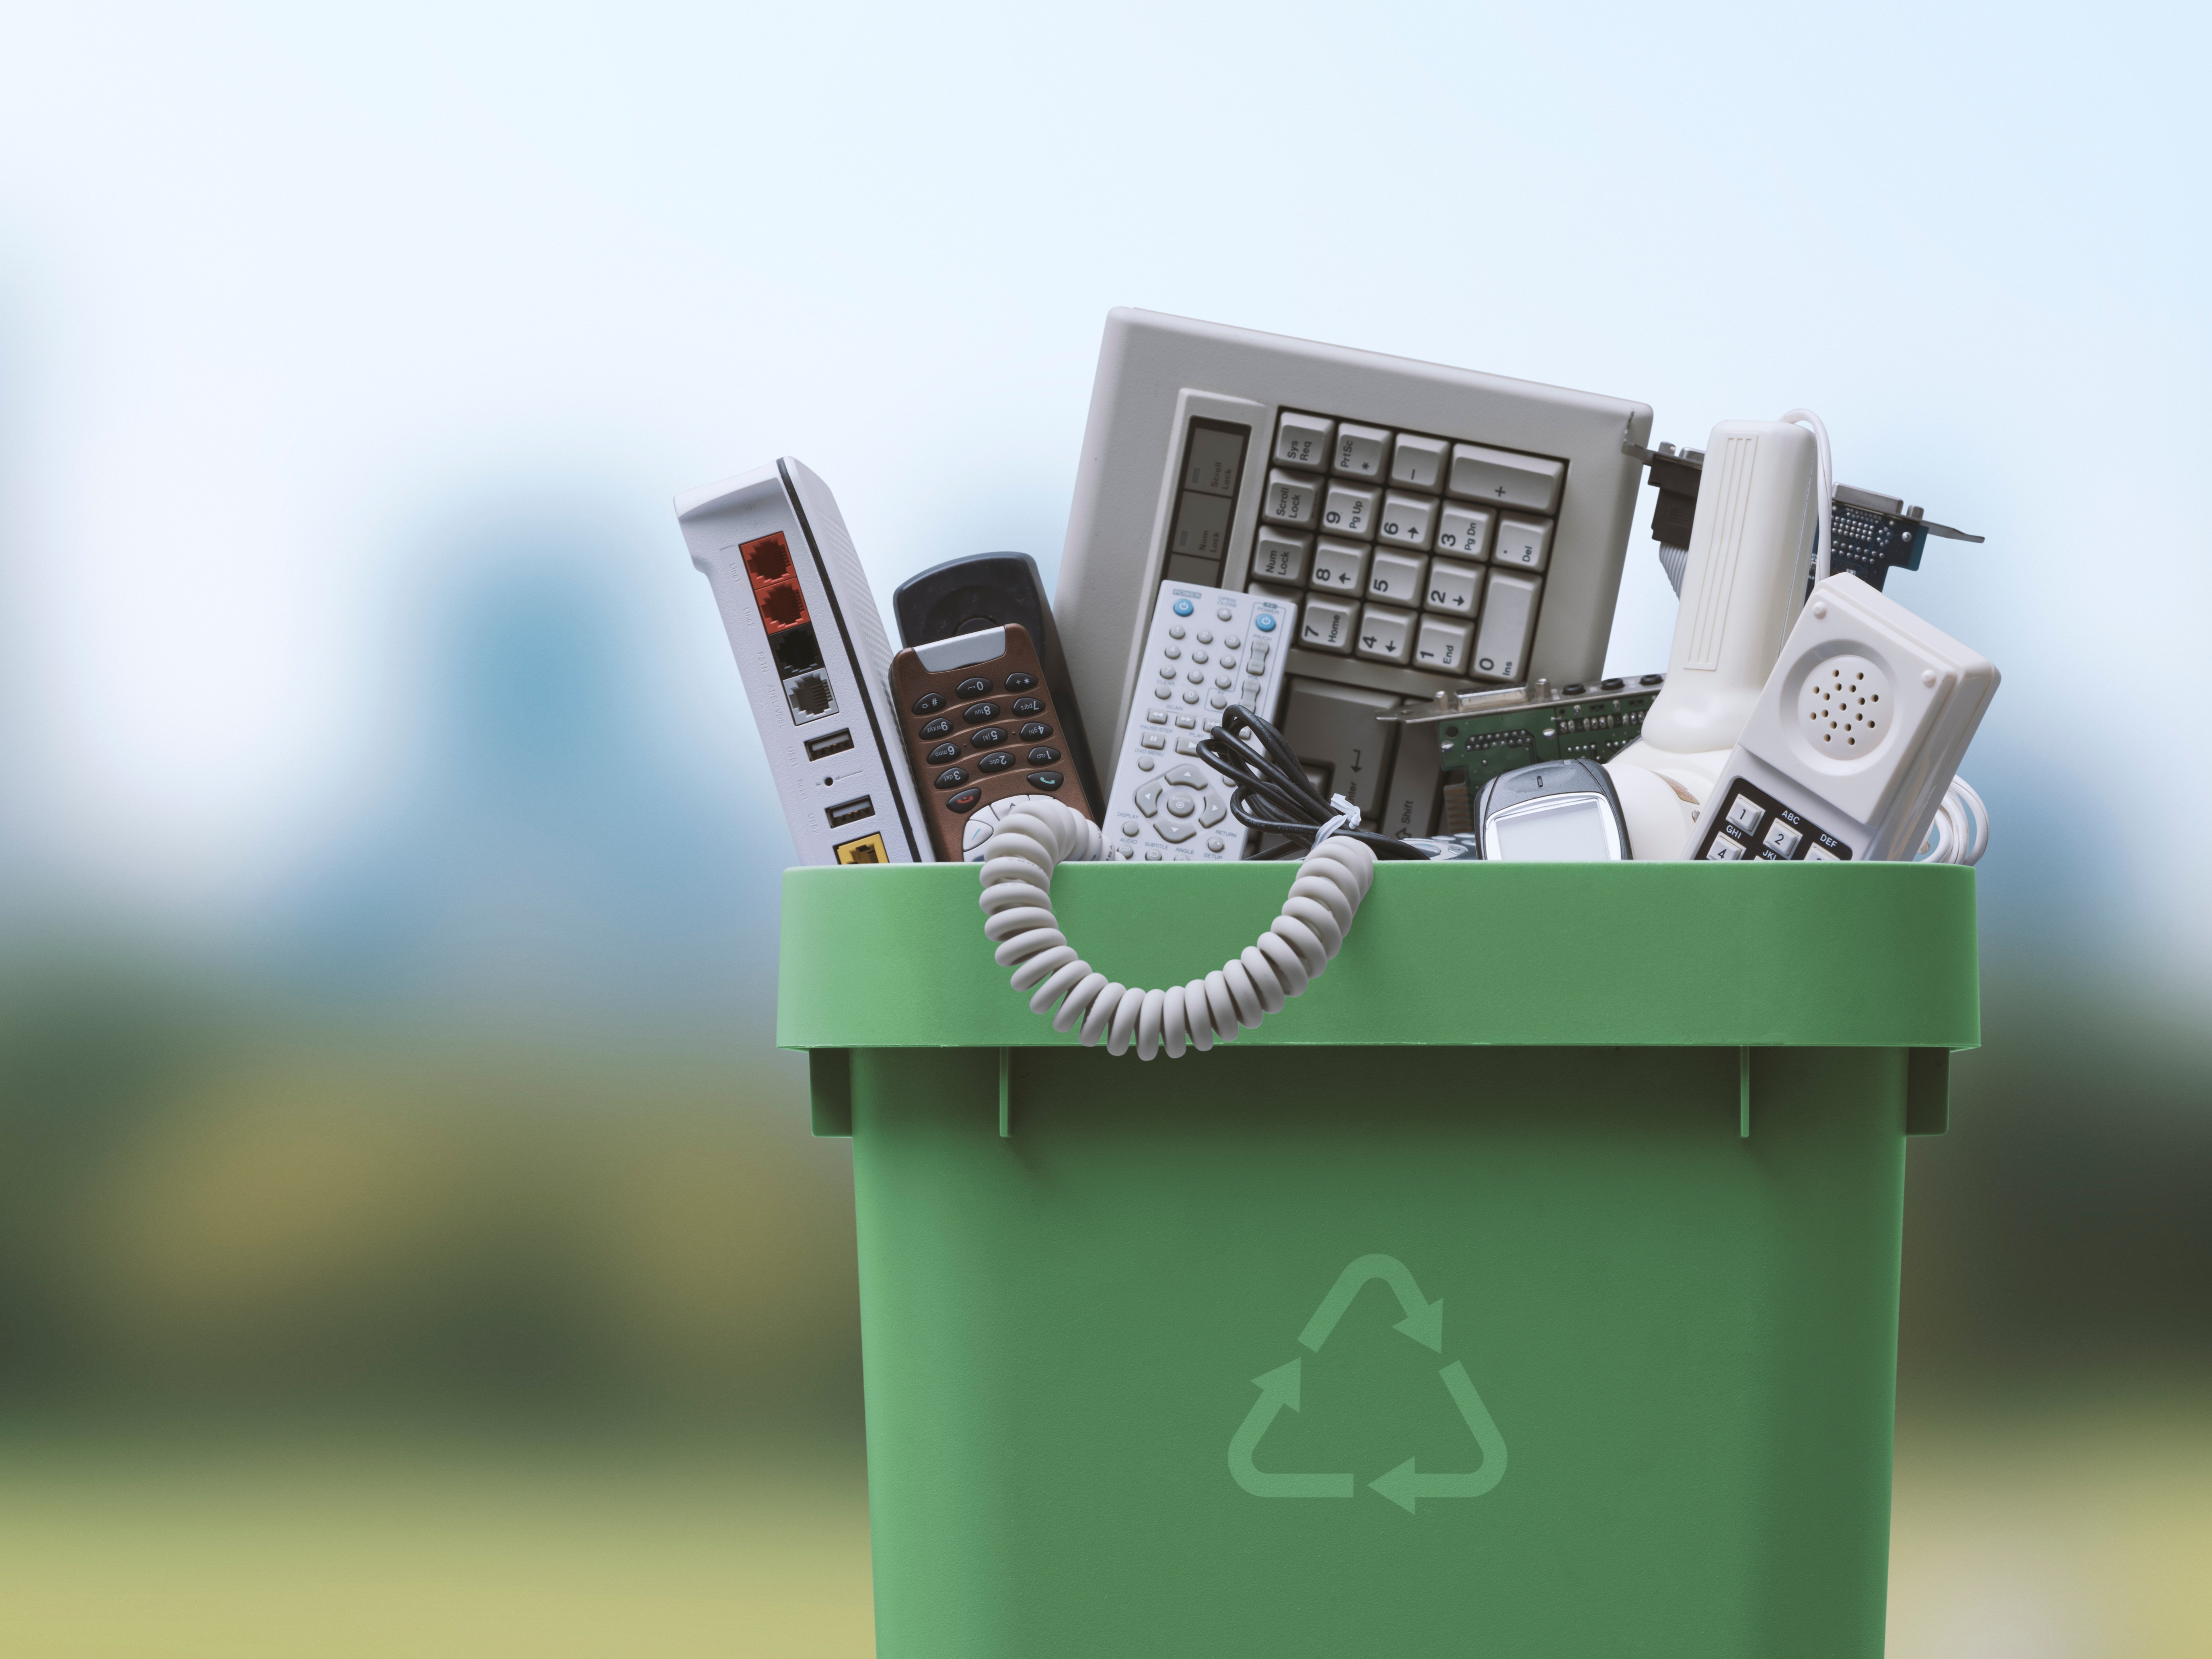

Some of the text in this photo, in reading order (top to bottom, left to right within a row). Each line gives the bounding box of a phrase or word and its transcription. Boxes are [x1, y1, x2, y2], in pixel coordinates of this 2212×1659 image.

[1287, 440, 1298, 458] Sys
[1300, 441, 1313, 461] Req
[1340, 440, 1353, 468] PrtSc
[1211, 462, 1222, 488] Scroll
[1222, 468, 1231, 490] Lock
[1276, 487, 1289, 516] Scroll
[1289, 494, 1301, 518] Lock
[1326, 511, 1340, 524] 9
[1349, 500, 1363, 529] Pg Up
[1384, 522, 1399, 535] 6
[1464, 522, 1476, 551] Pg Dn
[1199, 530, 1209, 551] Num
[1210, 532, 1219, 553] Lock
[1441, 533, 1456, 547] 3
[1266, 550, 1277, 573] Num
[1522, 545, 1533, 562] Del
[1278, 551, 1289, 576] Lock
[729, 562, 741, 584] Line1
[1316, 568, 1330, 582] 8
[1174, 590, 1201, 598] POWER
[1373, 579, 1388, 592] 5
[1431, 590, 1446, 604] 2
[743, 606, 754, 629] Line2
[1257, 606, 1280, 615] POWER
[1304, 625, 1319, 637] 7
[1328, 615, 1340, 643] Home
[1362, 636, 1377, 649] 4
[757, 651, 769, 674] PSTN
[1420, 650, 1434, 658] 1
[1443, 645, 1454, 664] End
[1479, 658, 1494, 671] 0
[1502, 661, 1513, 676] Ins
[767, 685, 786, 730] ADSL/VDSL
[1140, 724, 1173, 734] PAUSE/STEP
[787, 746, 798, 768] USB1
[797, 779, 808, 802] Reset
[1348, 781, 1357, 804] nter
[1117, 812, 1139, 820] DISPLAY
[1401, 800, 1414, 824] Shift
[1739, 809, 1746, 820] 1
[1781, 810, 1801, 825] ABC
[808, 813, 820, 835] USB2
[1244, 818, 1266, 827] CABLE
[1277, 826, 1314, 835] YISHENDA
[1726, 824, 1742, 839] GHI
[1215, 829, 1237, 838] RETURN
[1774, 833, 1784, 845] 2
[1820, 833, 1838, 847] DEF
[1144, 841, 1169, 850] SUBTITLE
[1175, 847, 1195, 855] ANGLE
[1717, 848, 1727, 859] 4
